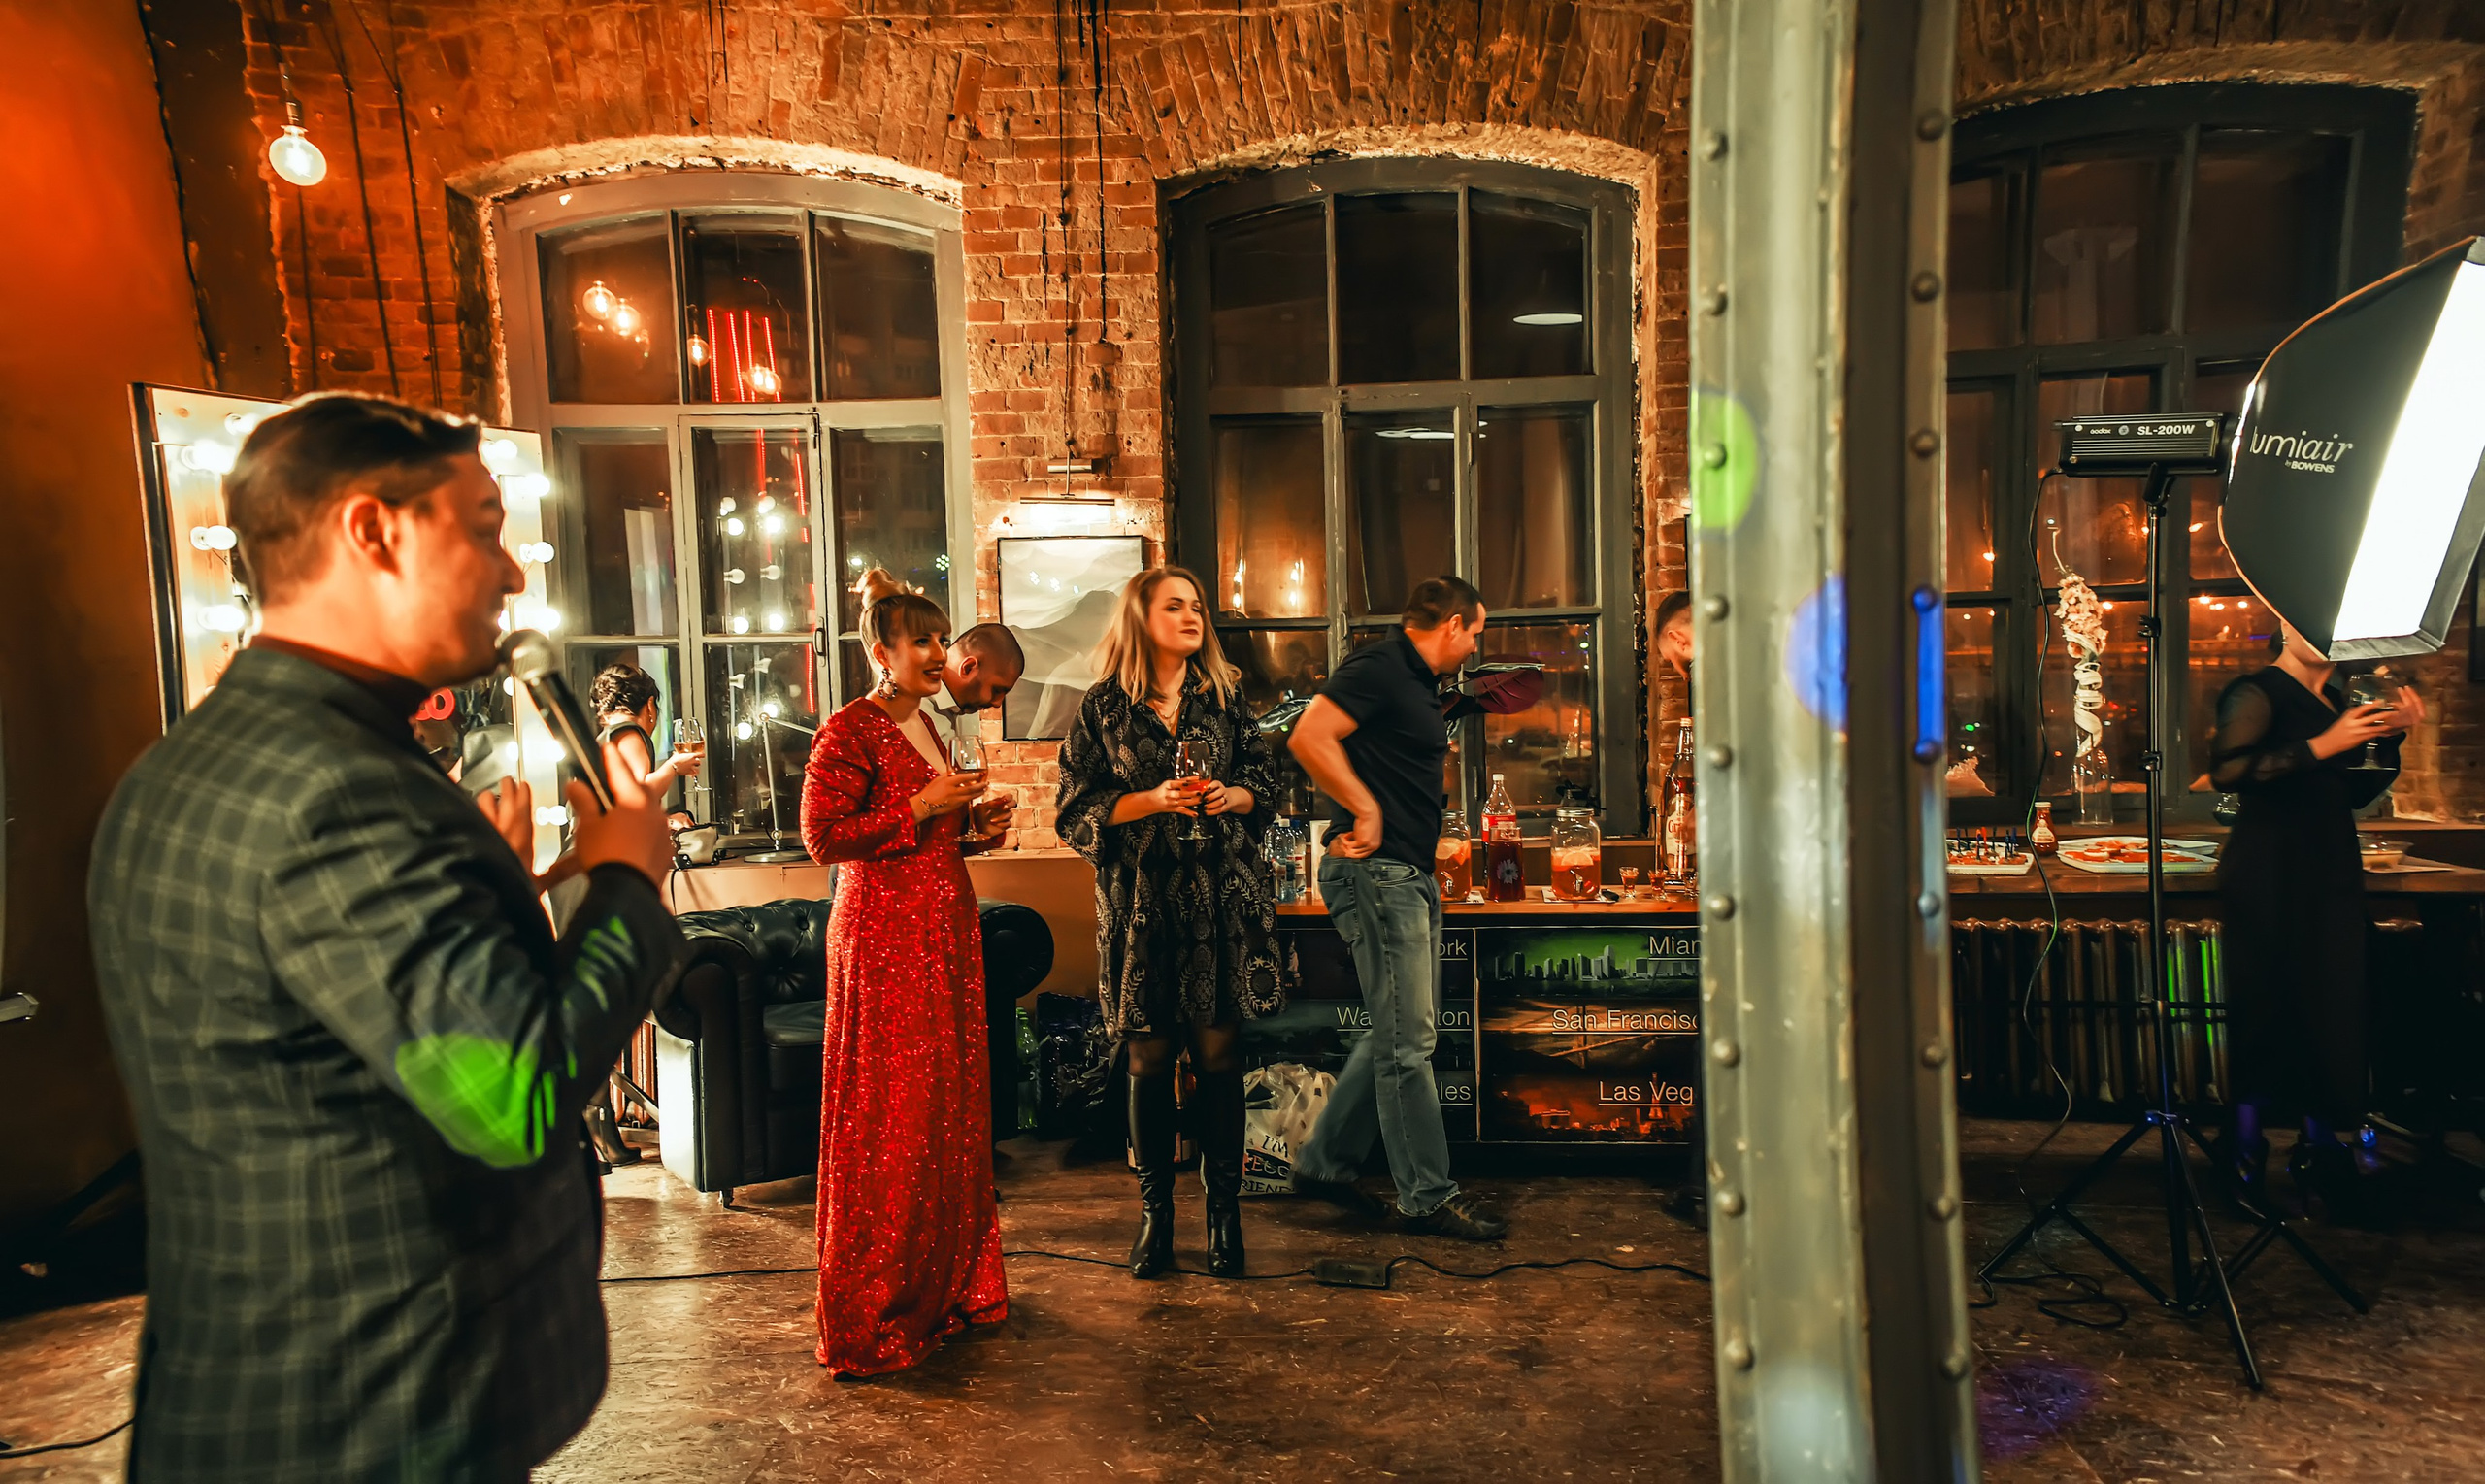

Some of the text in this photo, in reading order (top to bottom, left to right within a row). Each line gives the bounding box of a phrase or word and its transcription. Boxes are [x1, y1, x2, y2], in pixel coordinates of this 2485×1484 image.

[2137, 424, 2195, 436] SL-200W
[2291, 461, 2336, 474] BOWENS
[1439, 938, 1468, 957] ork
[1553, 1009, 1698, 1030] San Francis
[1600, 1080, 1694, 1105] Las Veg
